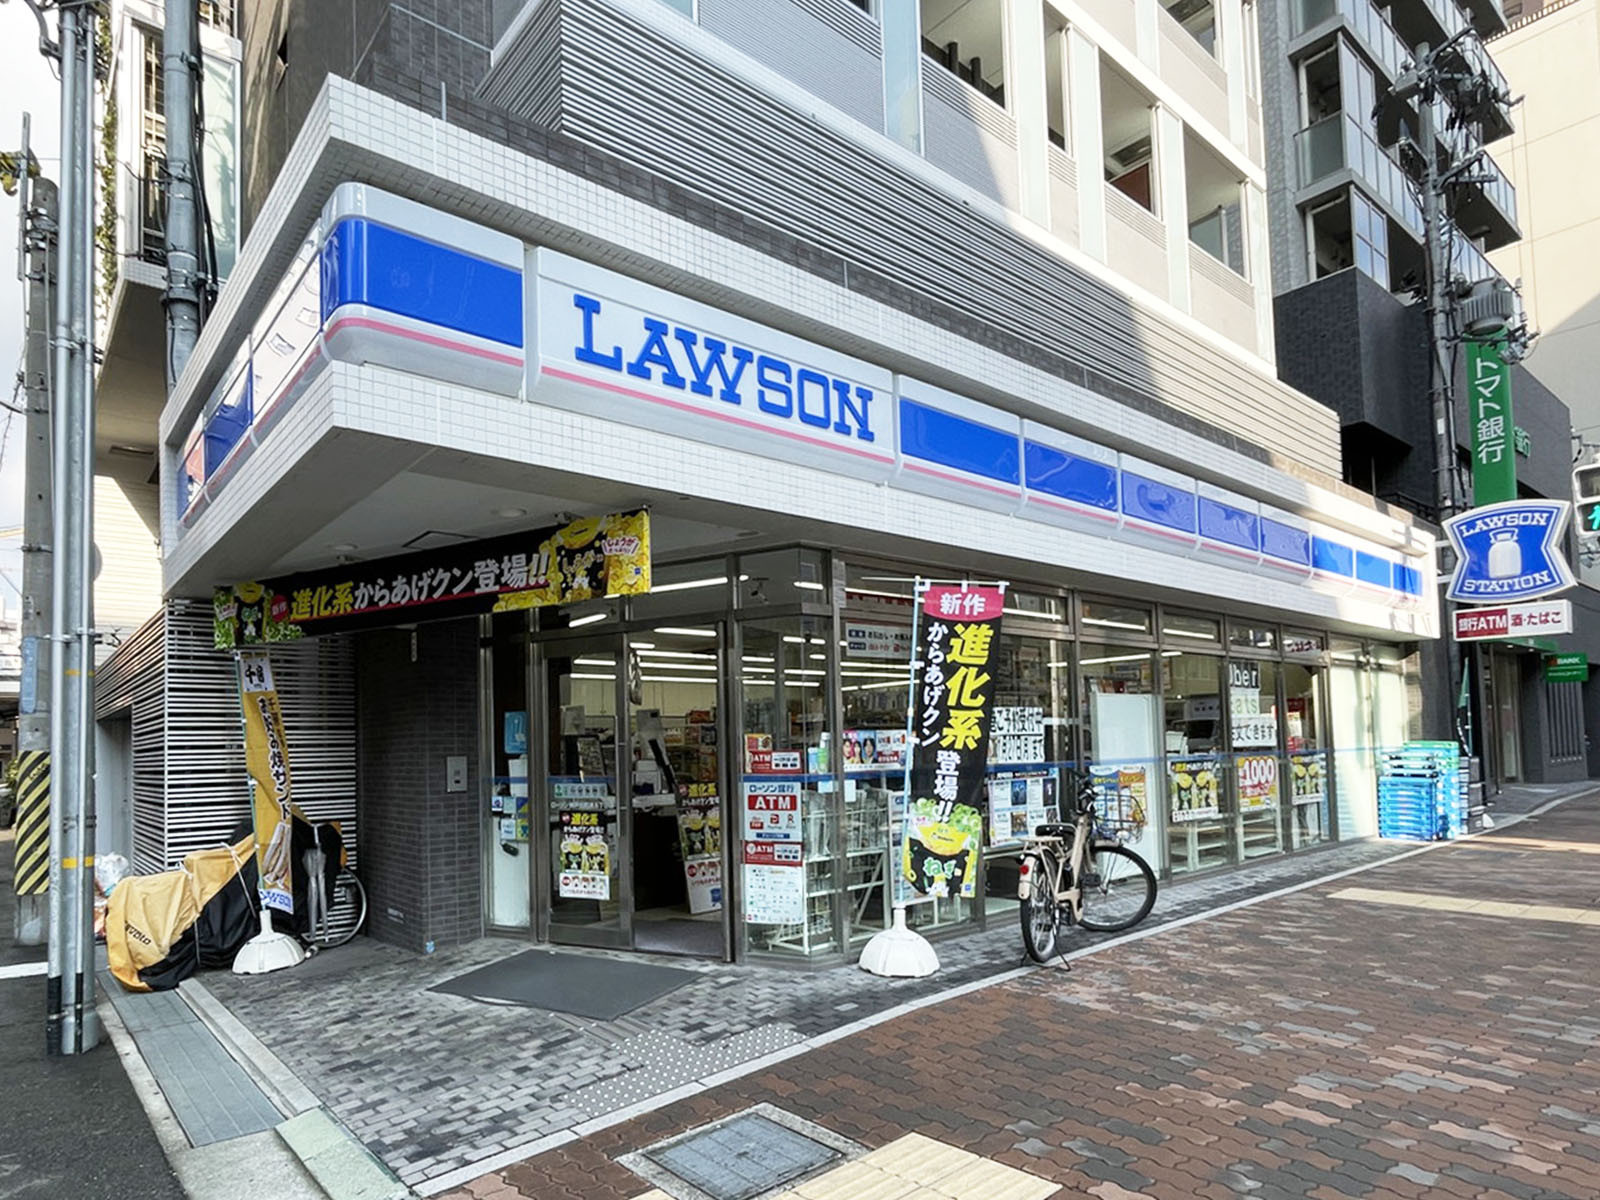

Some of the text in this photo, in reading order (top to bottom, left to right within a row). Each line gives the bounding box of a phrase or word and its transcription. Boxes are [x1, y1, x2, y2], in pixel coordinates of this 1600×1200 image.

[574, 294, 875, 442] LAWSON
[1475, 357, 1506, 465] トマト銀行
[1460, 512, 1551, 538] LAWSON
[1463, 570, 1552, 592] STATION
[940, 592, 986, 616] 新作
[922, 621, 949, 748] からあげクン
[939, 622, 994, 751] 進化系
[1231, 694, 1258, 714] ats
[755, 796, 791, 810] ATM
